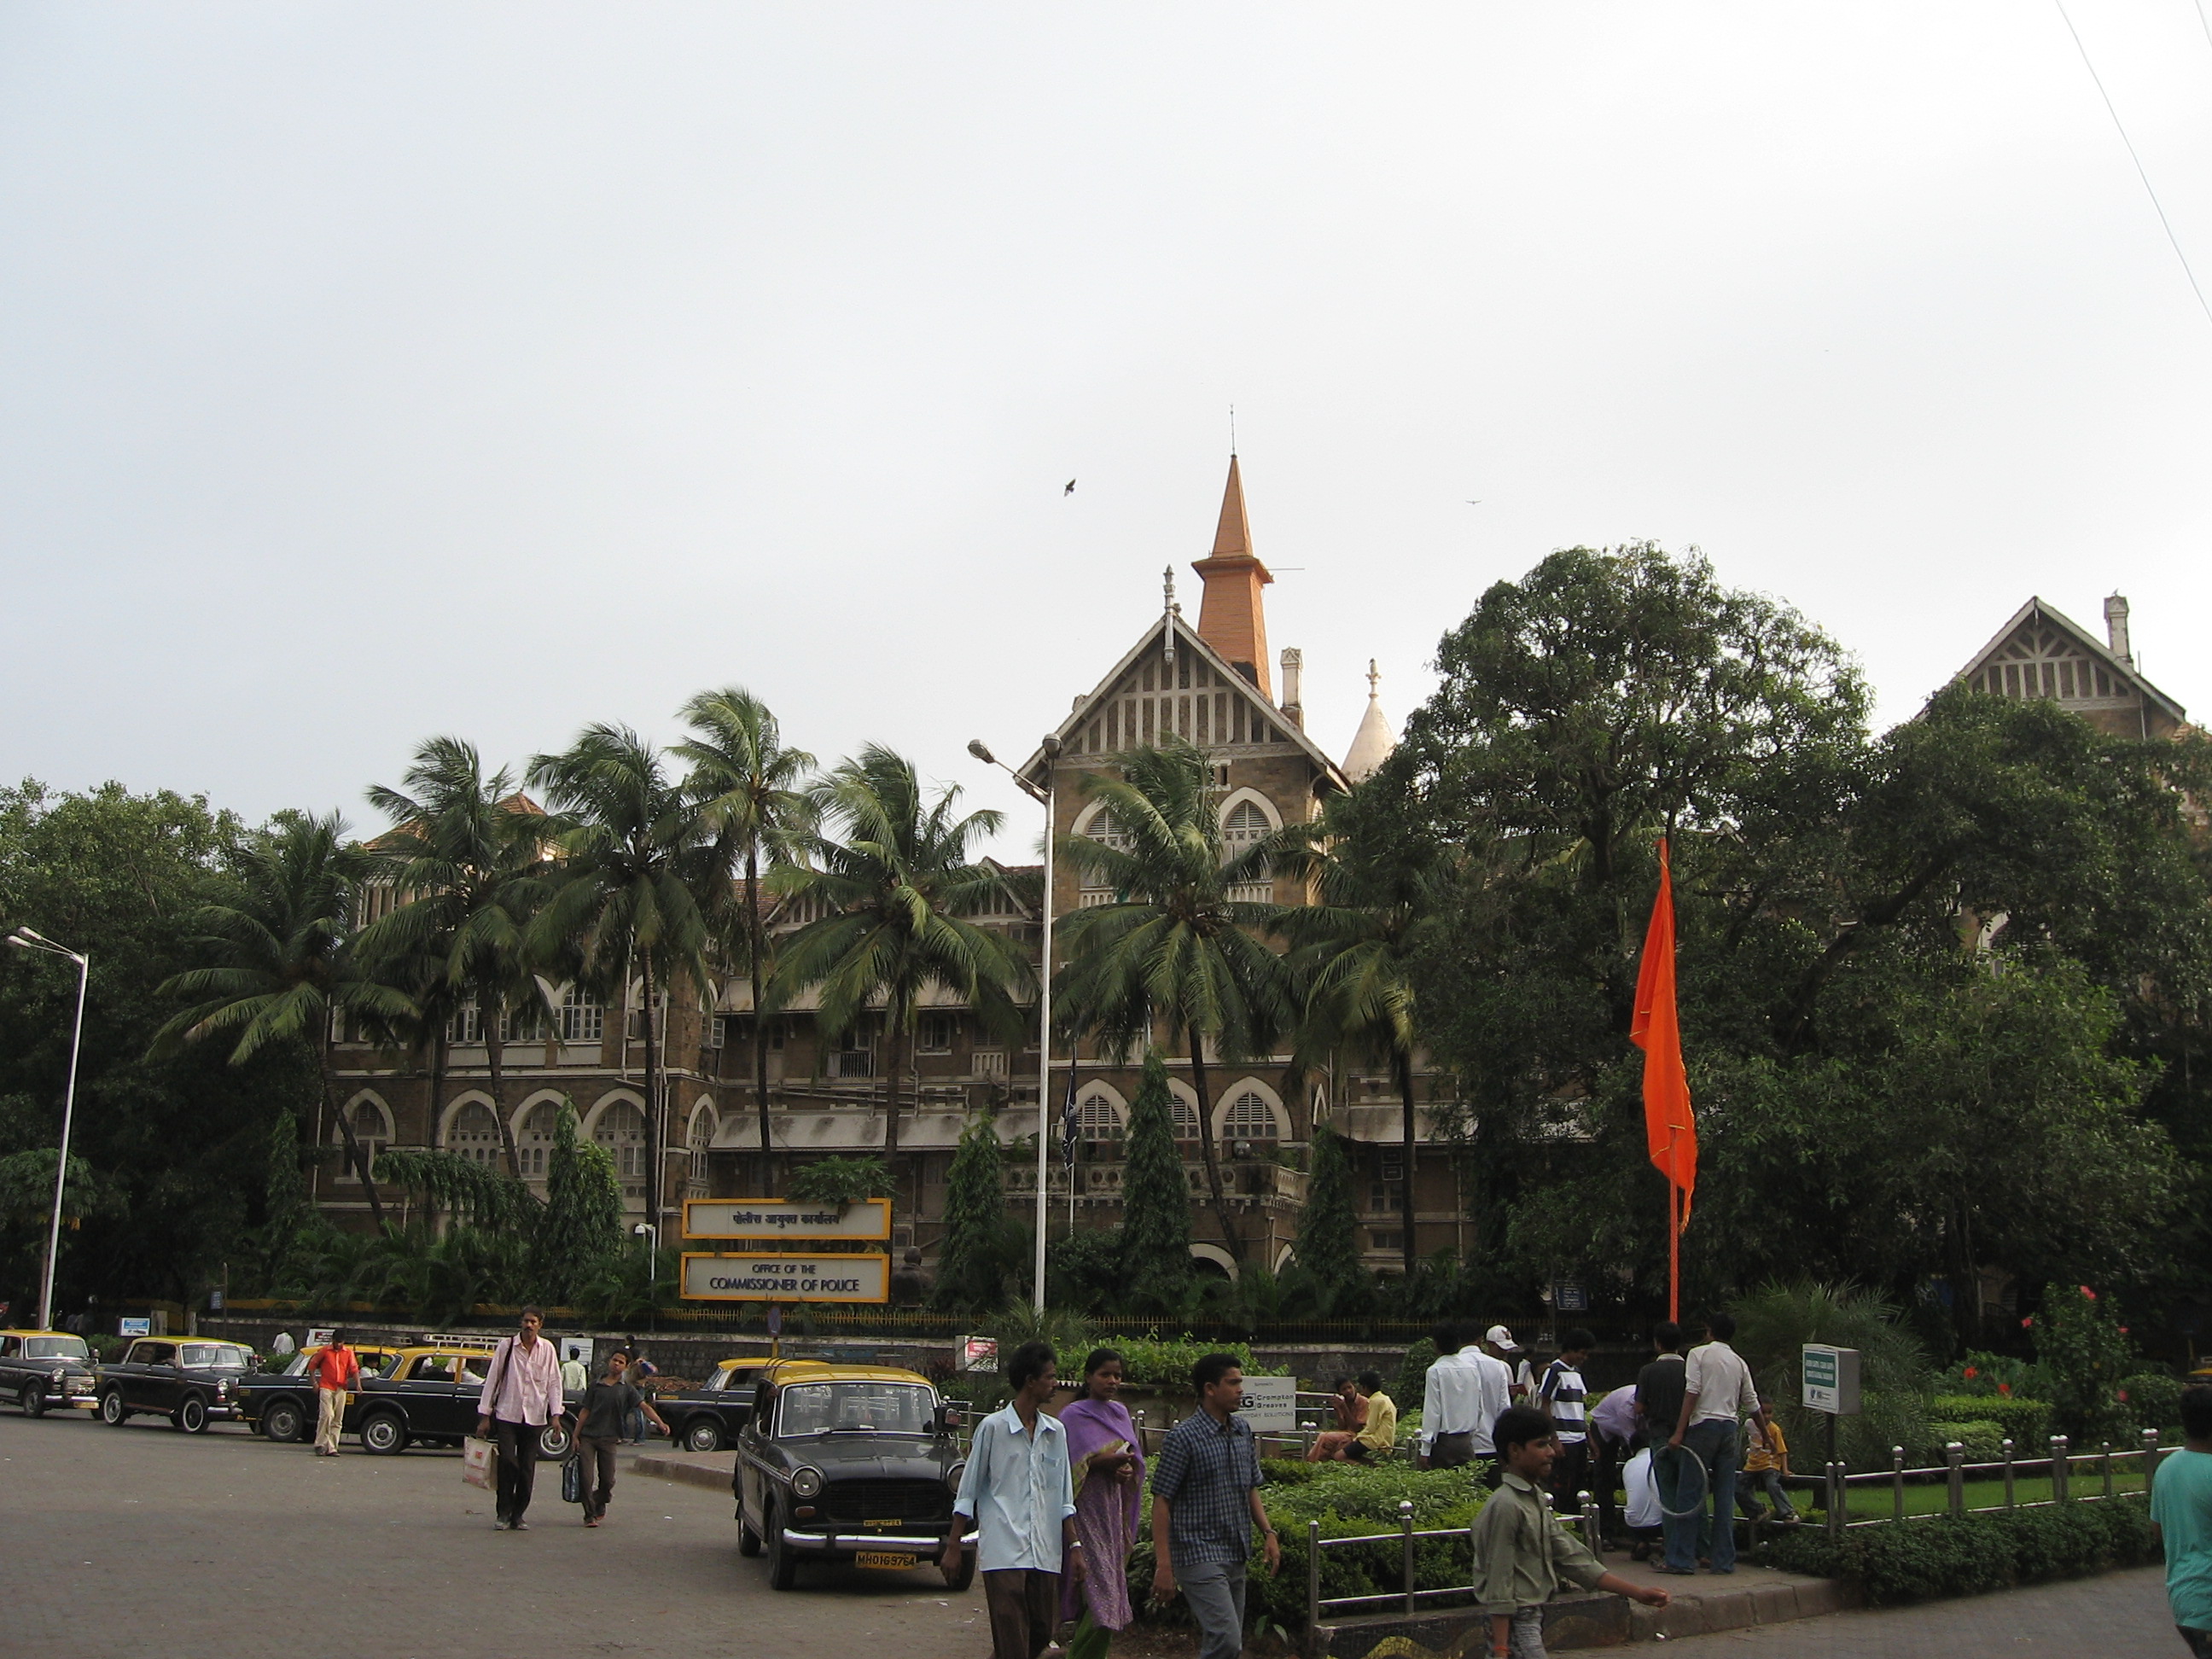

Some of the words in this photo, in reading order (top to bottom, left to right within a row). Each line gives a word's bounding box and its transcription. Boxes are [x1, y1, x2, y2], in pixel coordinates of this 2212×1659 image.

[732, 1211, 762, 1225] पोलीस
[765, 1213, 798, 1228] आयुक्त
[800, 1211, 841, 1225] कार्यालय
[752, 1264, 781, 1274] OFFICE
[784, 1264, 797, 1274] OF
[800, 1264, 817, 1275] THE
[709, 1277, 797, 1291] COMMISSIONER
[800, 1279, 818, 1292] OF
[820, 1279, 860, 1292] POLICE
